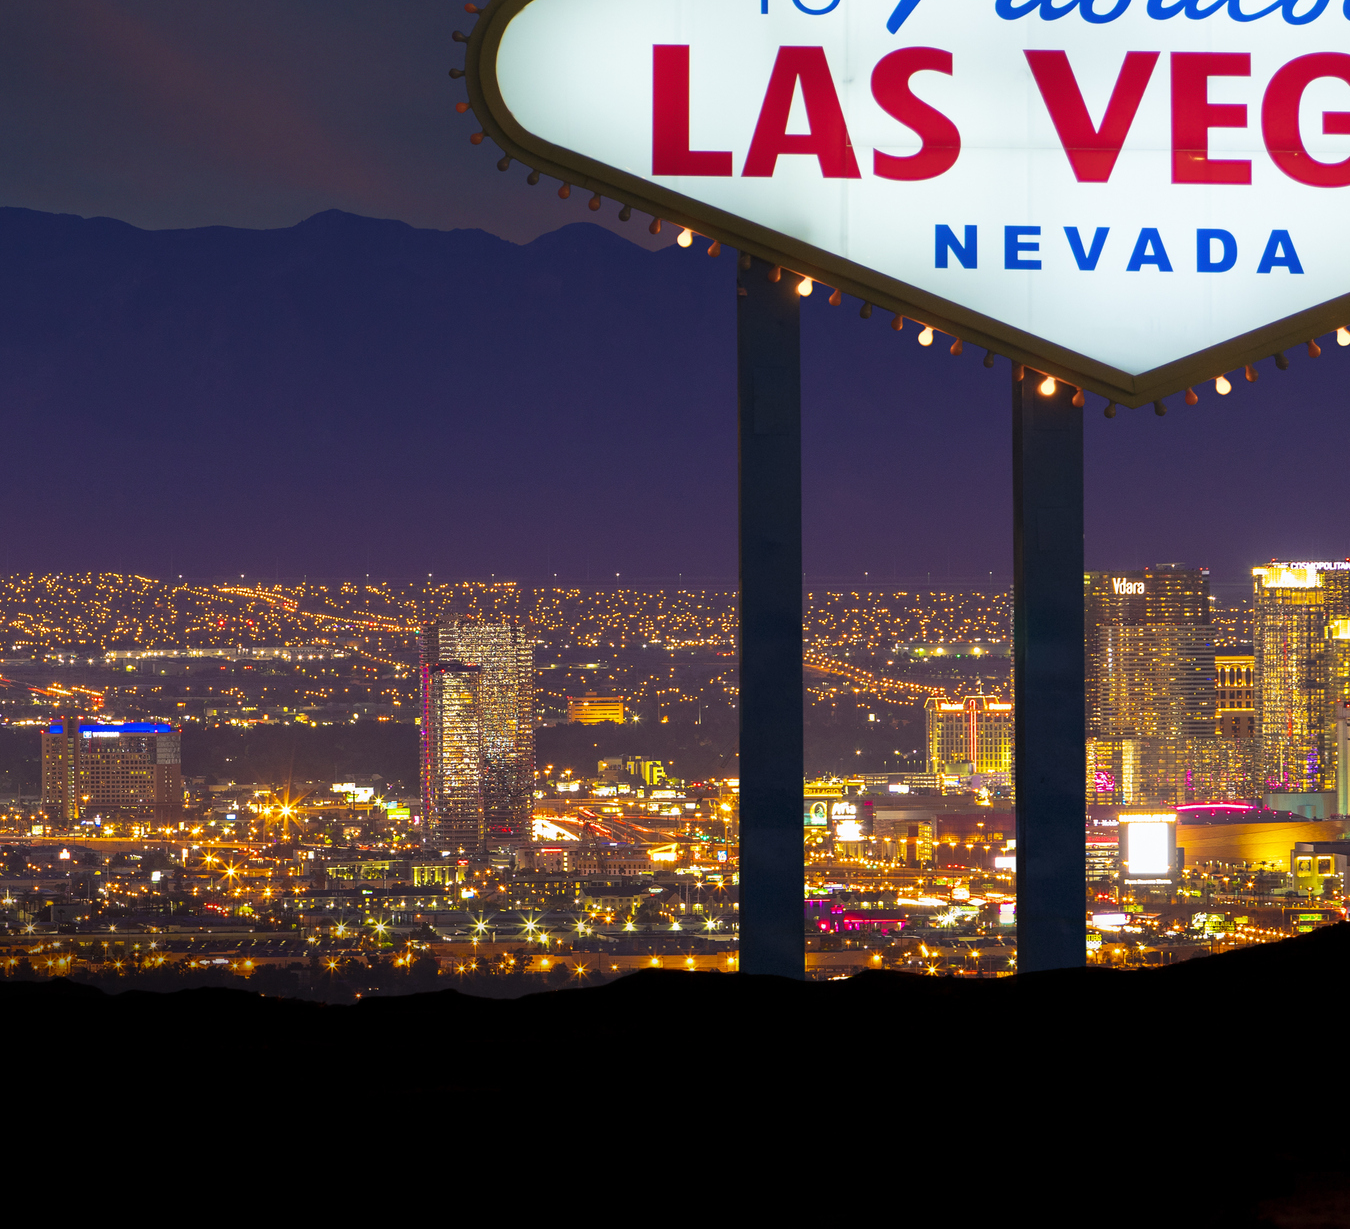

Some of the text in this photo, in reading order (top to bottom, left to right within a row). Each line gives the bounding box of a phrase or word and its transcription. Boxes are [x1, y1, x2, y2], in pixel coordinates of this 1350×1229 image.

[653, 45, 961, 181] LAS
[934, 223, 1305, 275] NEVADA
[1112, 577, 1145, 595] Vdara
